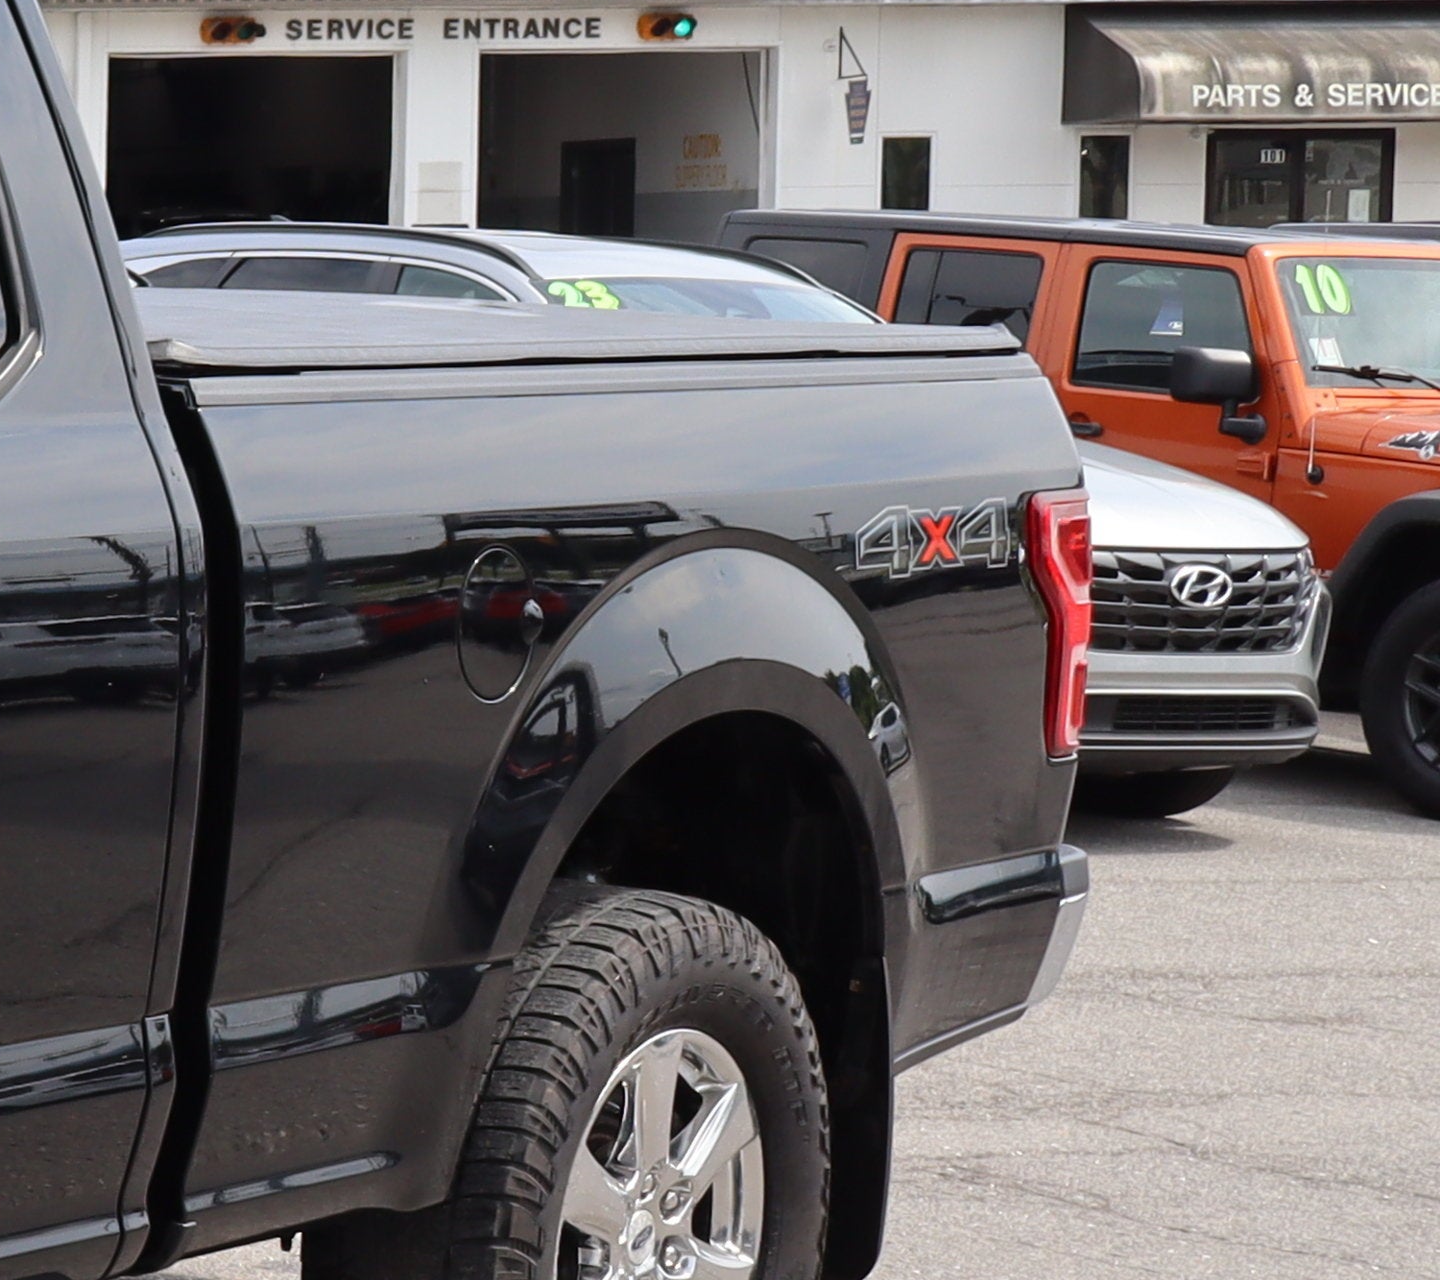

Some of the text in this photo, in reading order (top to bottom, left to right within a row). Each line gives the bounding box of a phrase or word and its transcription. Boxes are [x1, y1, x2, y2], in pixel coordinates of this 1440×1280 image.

[285, 17, 602, 40] SERVICE ENTRANCE
[1192, 84, 1281, 108] PARTS
[1294, 83, 1315, 108] &
[1262, 148, 1285, 164] 101
[547, 280, 621, 310] 23
[1295, 264, 1352, 316] 10
